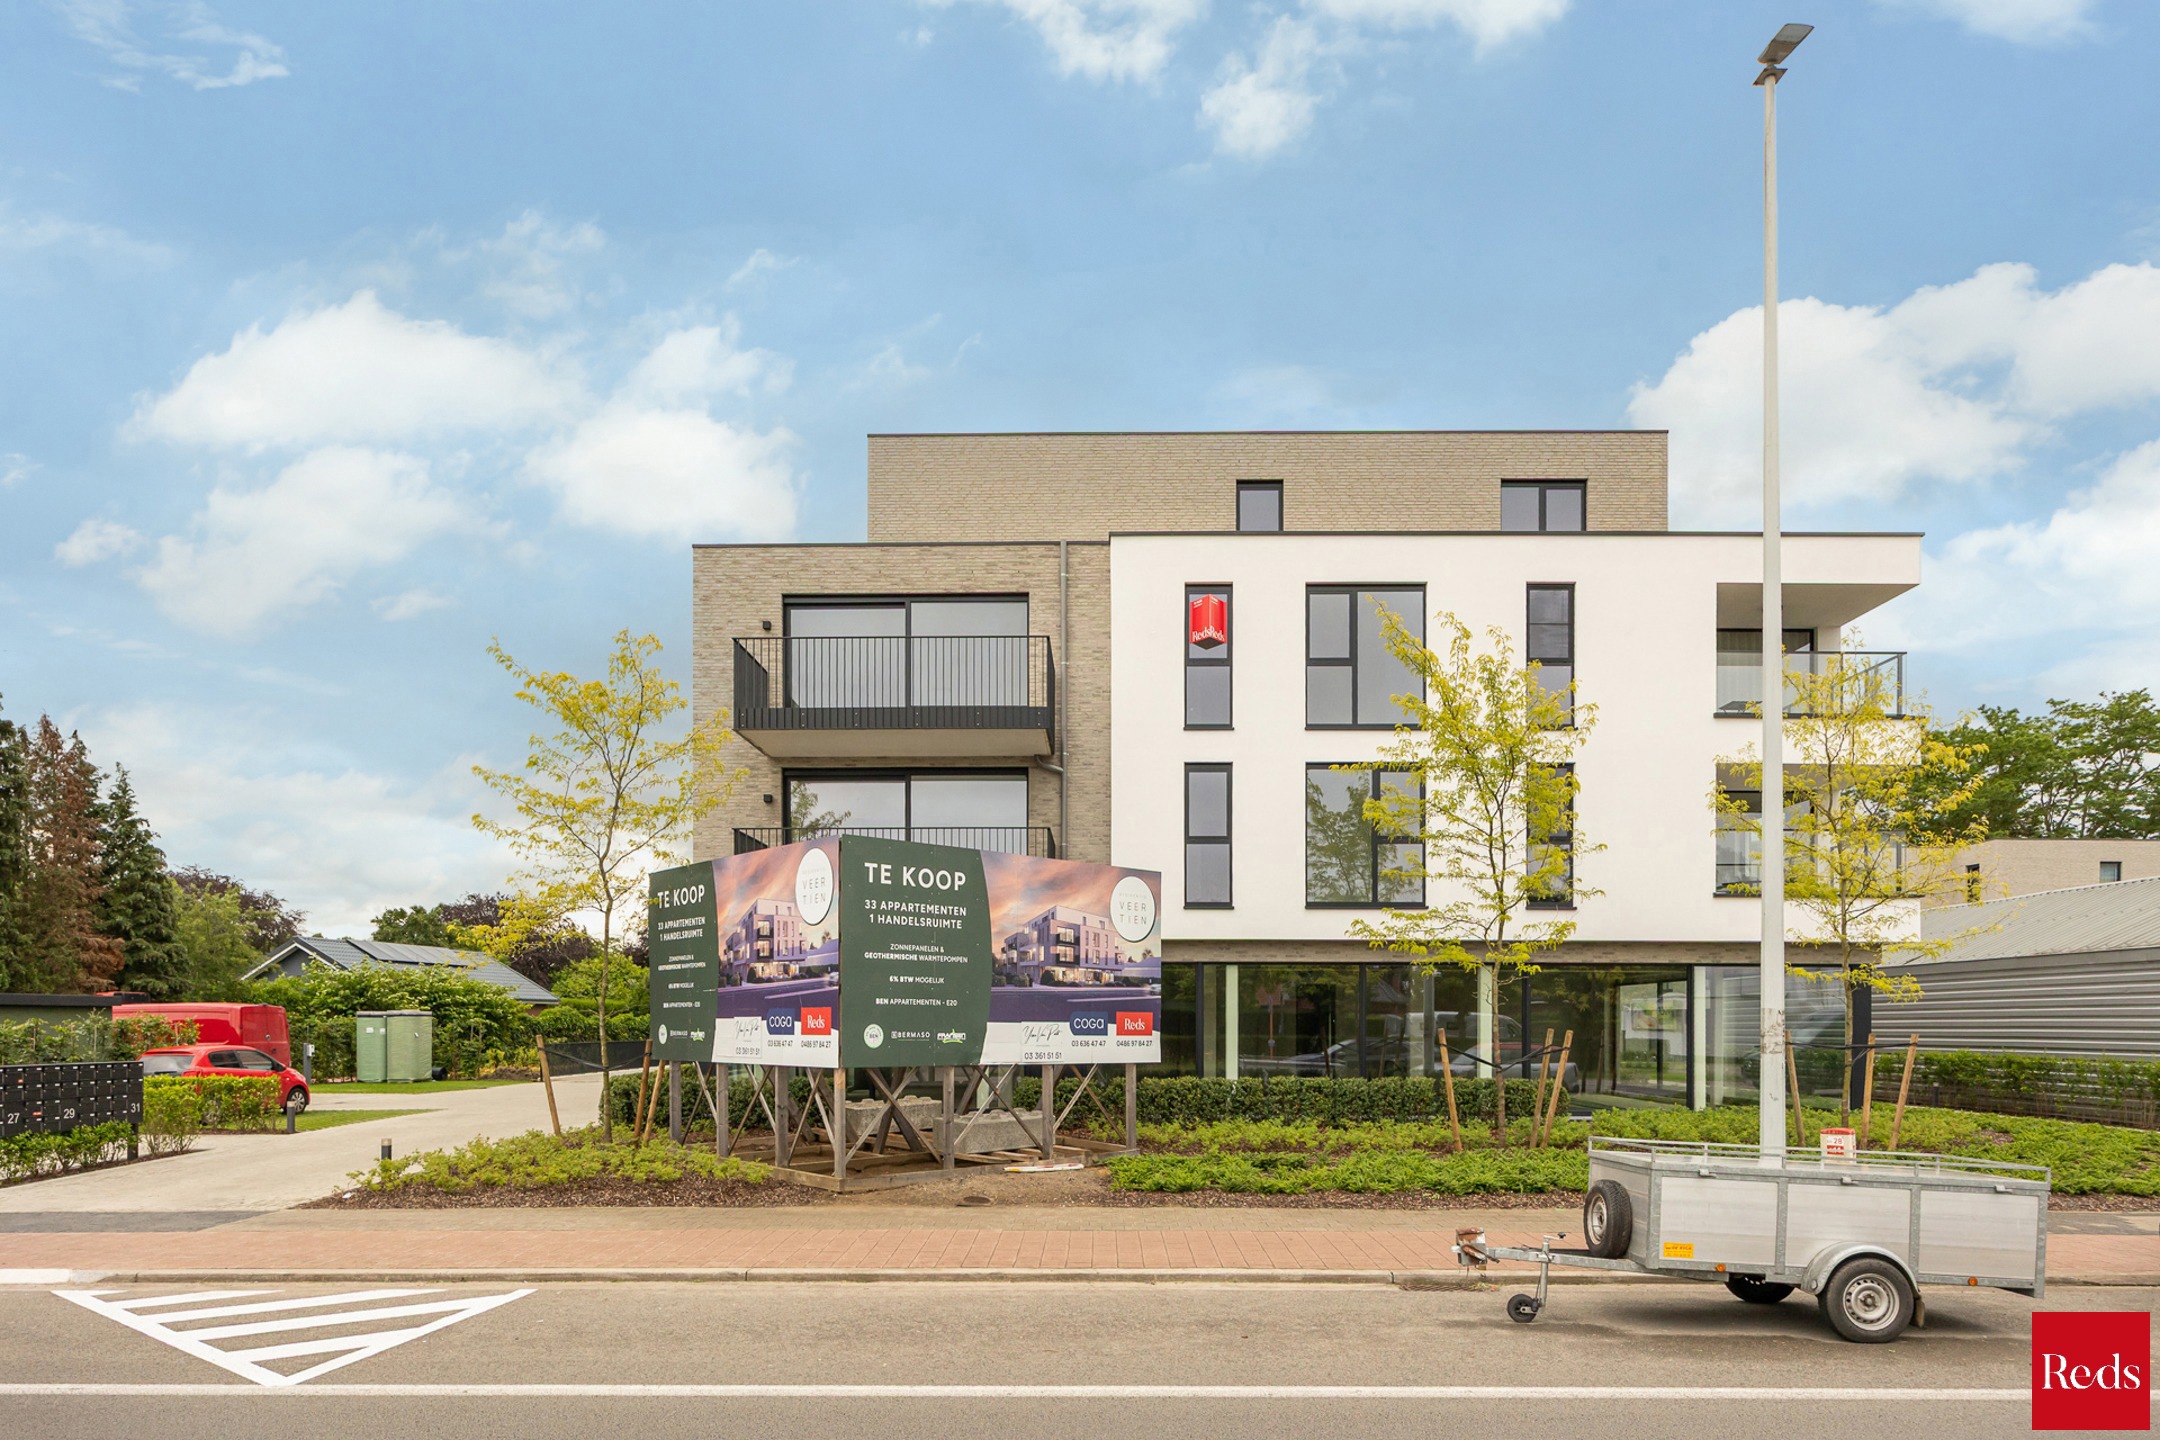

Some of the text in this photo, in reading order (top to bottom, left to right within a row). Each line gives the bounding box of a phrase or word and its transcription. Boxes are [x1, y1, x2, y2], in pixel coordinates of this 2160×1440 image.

[802, 876, 825, 889] VEER
[864, 862, 966, 891] TE KOOP
[657, 884, 705, 909] TE KOOP
[802, 893, 825, 905] TIEN
[864, 899, 967, 917] 33 APPARTEMENTEN
[1119, 901, 1147, 912] VEER
[664, 916, 706, 929] APPARTEMENTEN
[869, 913, 963, 930] 1 HANDELSRUIMTE
[1119, 914, 1147, 925] TIEN
[663, 928, 703, 941] HANDELSRUIMTE
[890, 943, 945, 954] ZONNEPANELEN &
[864, 952, 968, 964] GEOTHERMISCHE WARMTEPOMPEN
[889, 975, 899, 983] 6%
[915, 976, 945, 984] MOGELIJK
[890, 998, 941, 1006] APPARTEMENTEN
[946, 999, 958, 1007] E20
[807, 1014, 825, 1028] Reds
[1124, 1018, 1145, 1030] Reds
[1024, 1052, 1062, 1060] 03 361 51 51
[63, 1108, 75, 1119] 29
[130, 1103, 140, 1113] 31
[7, 1112, 20, 1124] 27
[1833, 1137, 1843, 1145] 28
